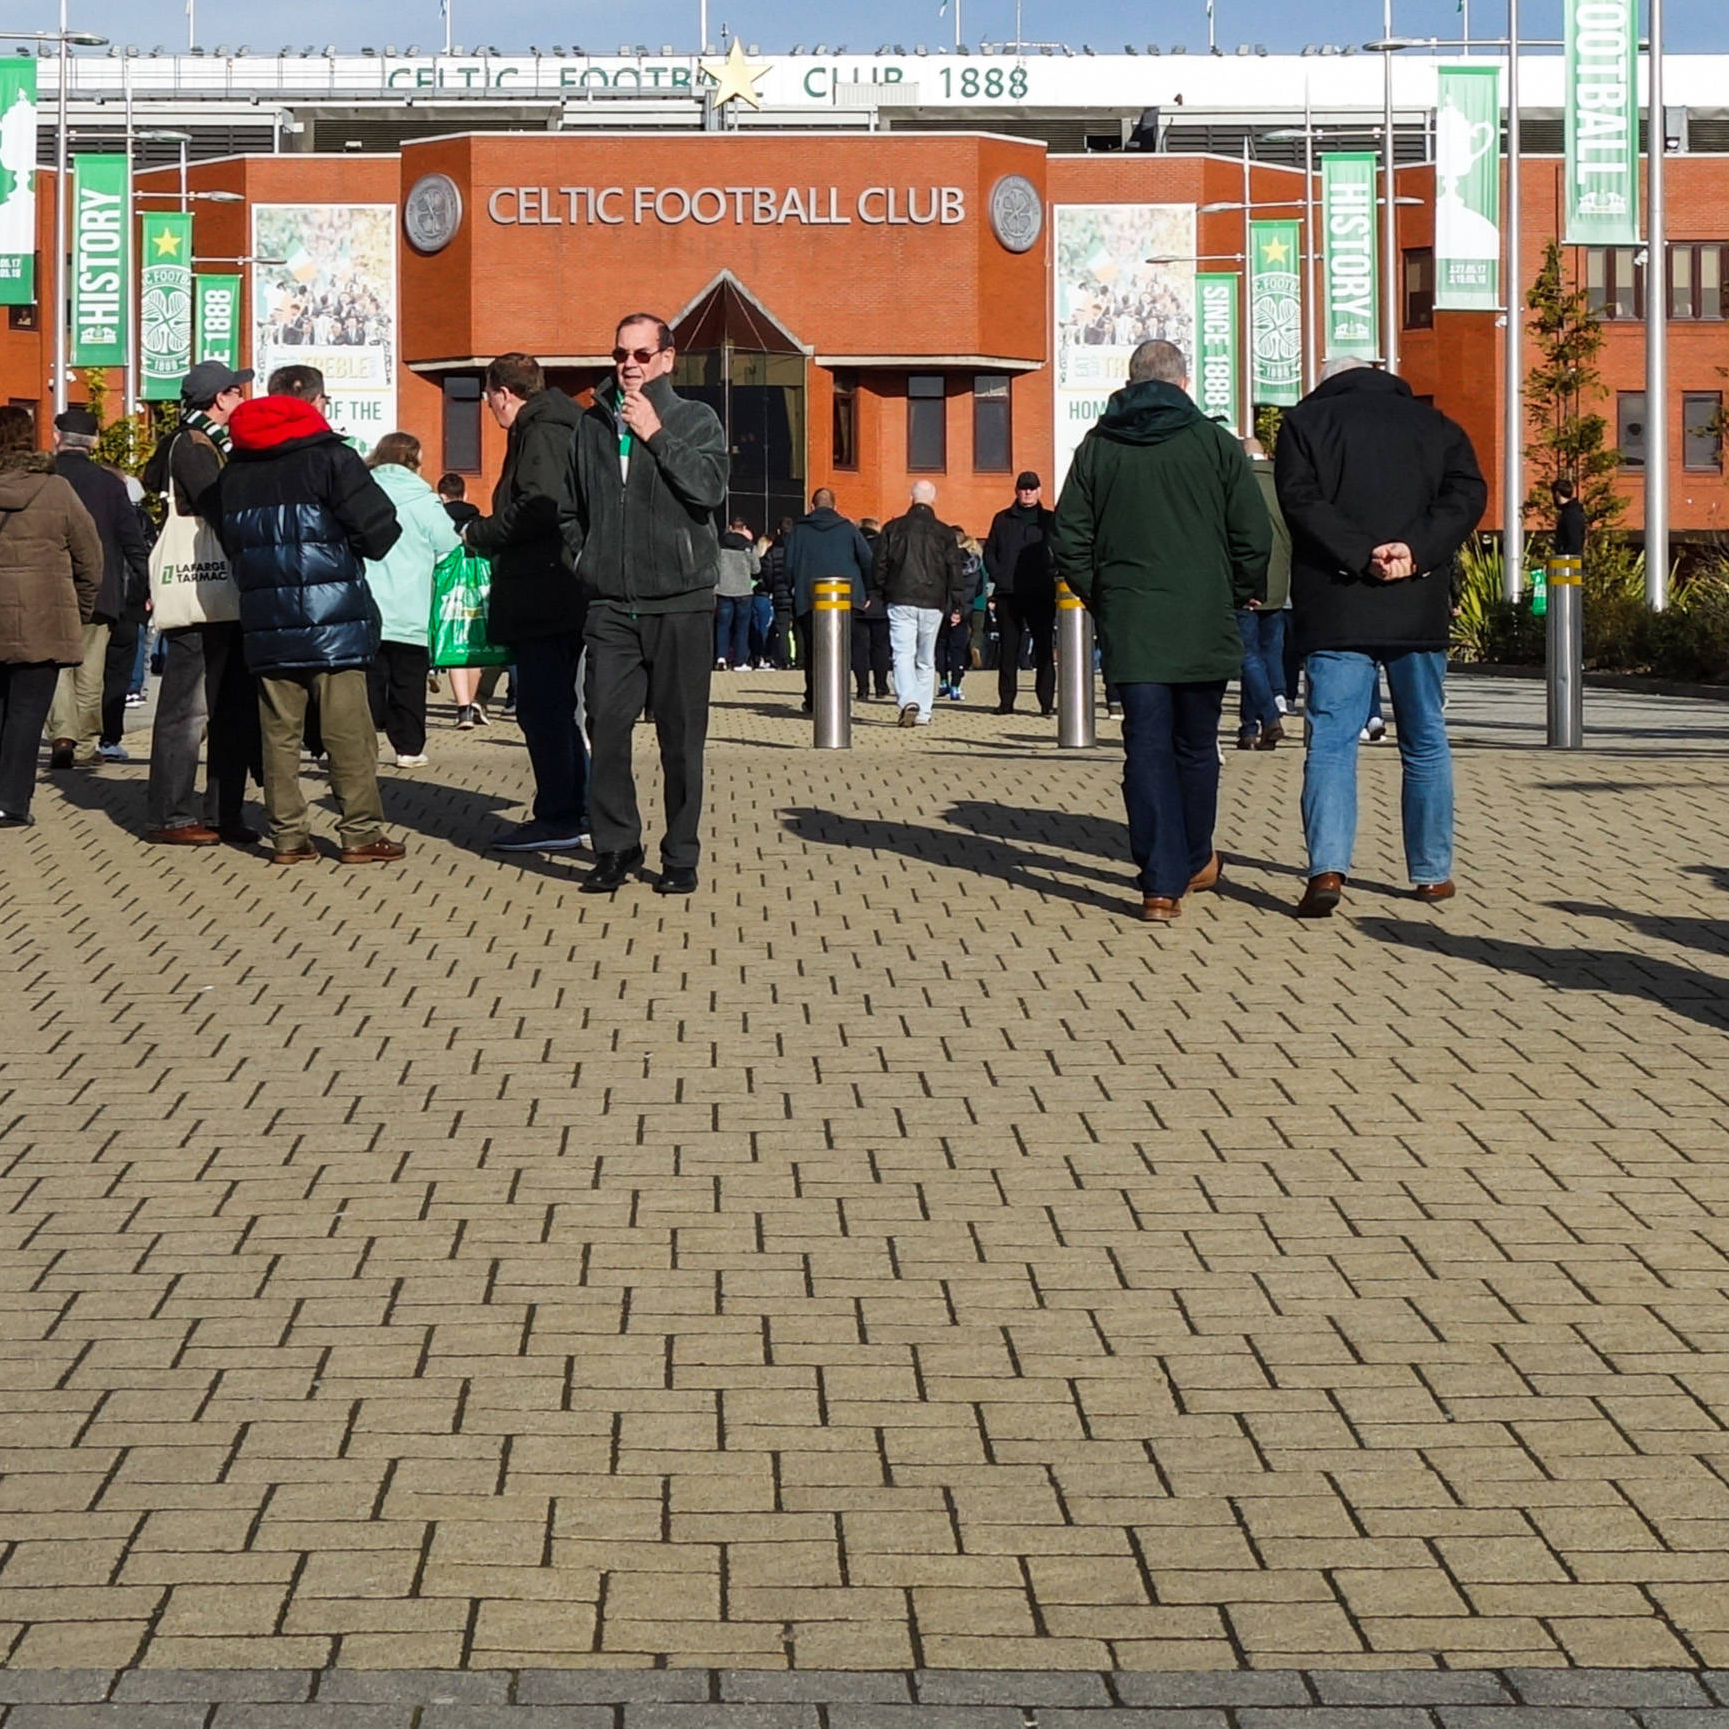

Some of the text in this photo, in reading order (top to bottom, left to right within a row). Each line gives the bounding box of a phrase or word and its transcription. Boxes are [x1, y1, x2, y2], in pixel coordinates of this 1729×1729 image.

[940, 67, 1029, 99] 1888
[487, 186, 966, 225] CELTIC FOOTBALL CLUB
[78, 188, 121, 324] HISTORY
[1330, 183, 1371, 318] HISTORY
[204, 289, 232, 341] 1888
[1203, 285, 1231, 405] SINCE 1888
[349, 400, 383, 420] THE
[1069, 400, 1108, 420] HOM
[176, 561, 226, 574] LAFARGE
[177, 571, 229, 584] TARMAC
